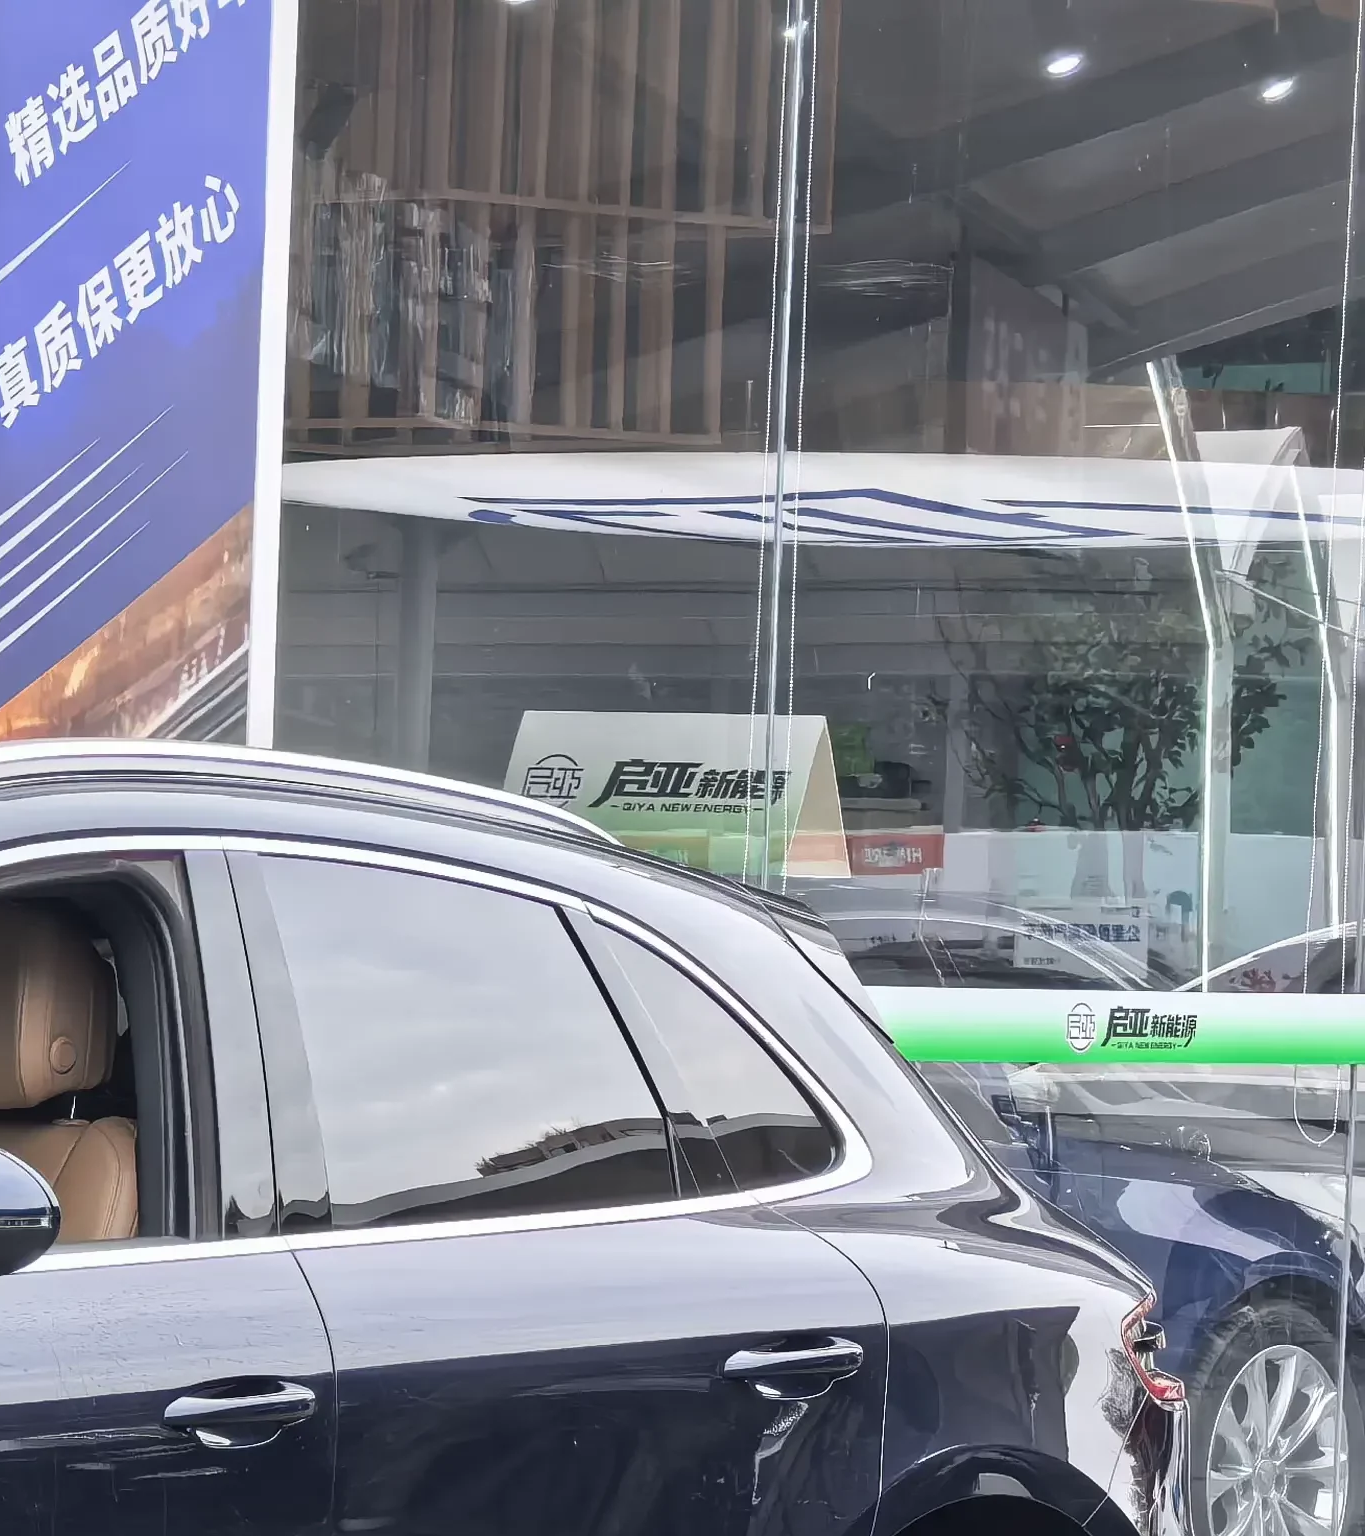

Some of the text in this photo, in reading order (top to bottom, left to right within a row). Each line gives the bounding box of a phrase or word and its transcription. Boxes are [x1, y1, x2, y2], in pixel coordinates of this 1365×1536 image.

[4, 0, 246, 187] 精选品质好
[588, 759, 791, 807] 启亚新能源
[622, 802, 750, 814] QIYA NEW ENERGY
[1100, 1006, 1198, 1047] 启亚新能源
